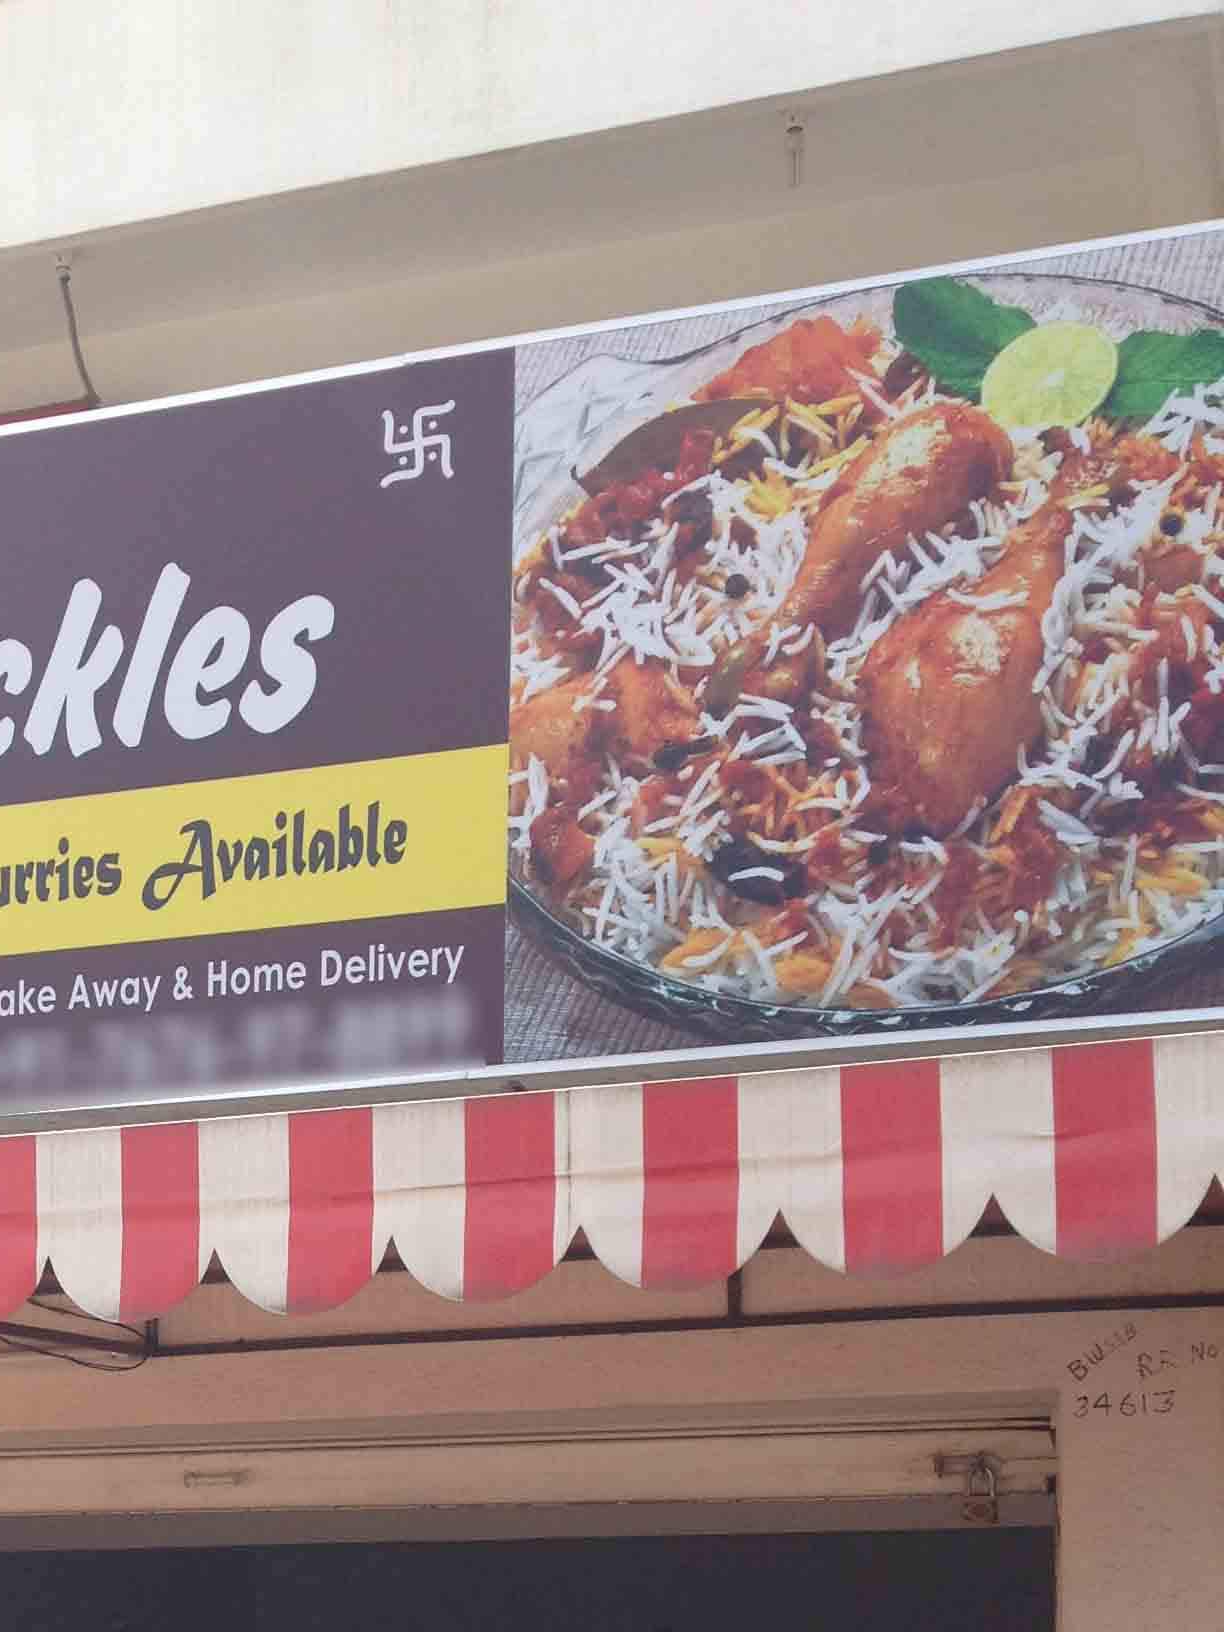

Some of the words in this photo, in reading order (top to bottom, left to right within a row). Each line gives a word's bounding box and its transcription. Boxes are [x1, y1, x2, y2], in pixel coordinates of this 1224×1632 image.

[141, 800, 408, 911] Available
[68, 974, 161, 1012] Away
[172, 966, 193, 1001] &
[207, 959, 307, 997] Home
[320, 944, 465, 986] Delivery
